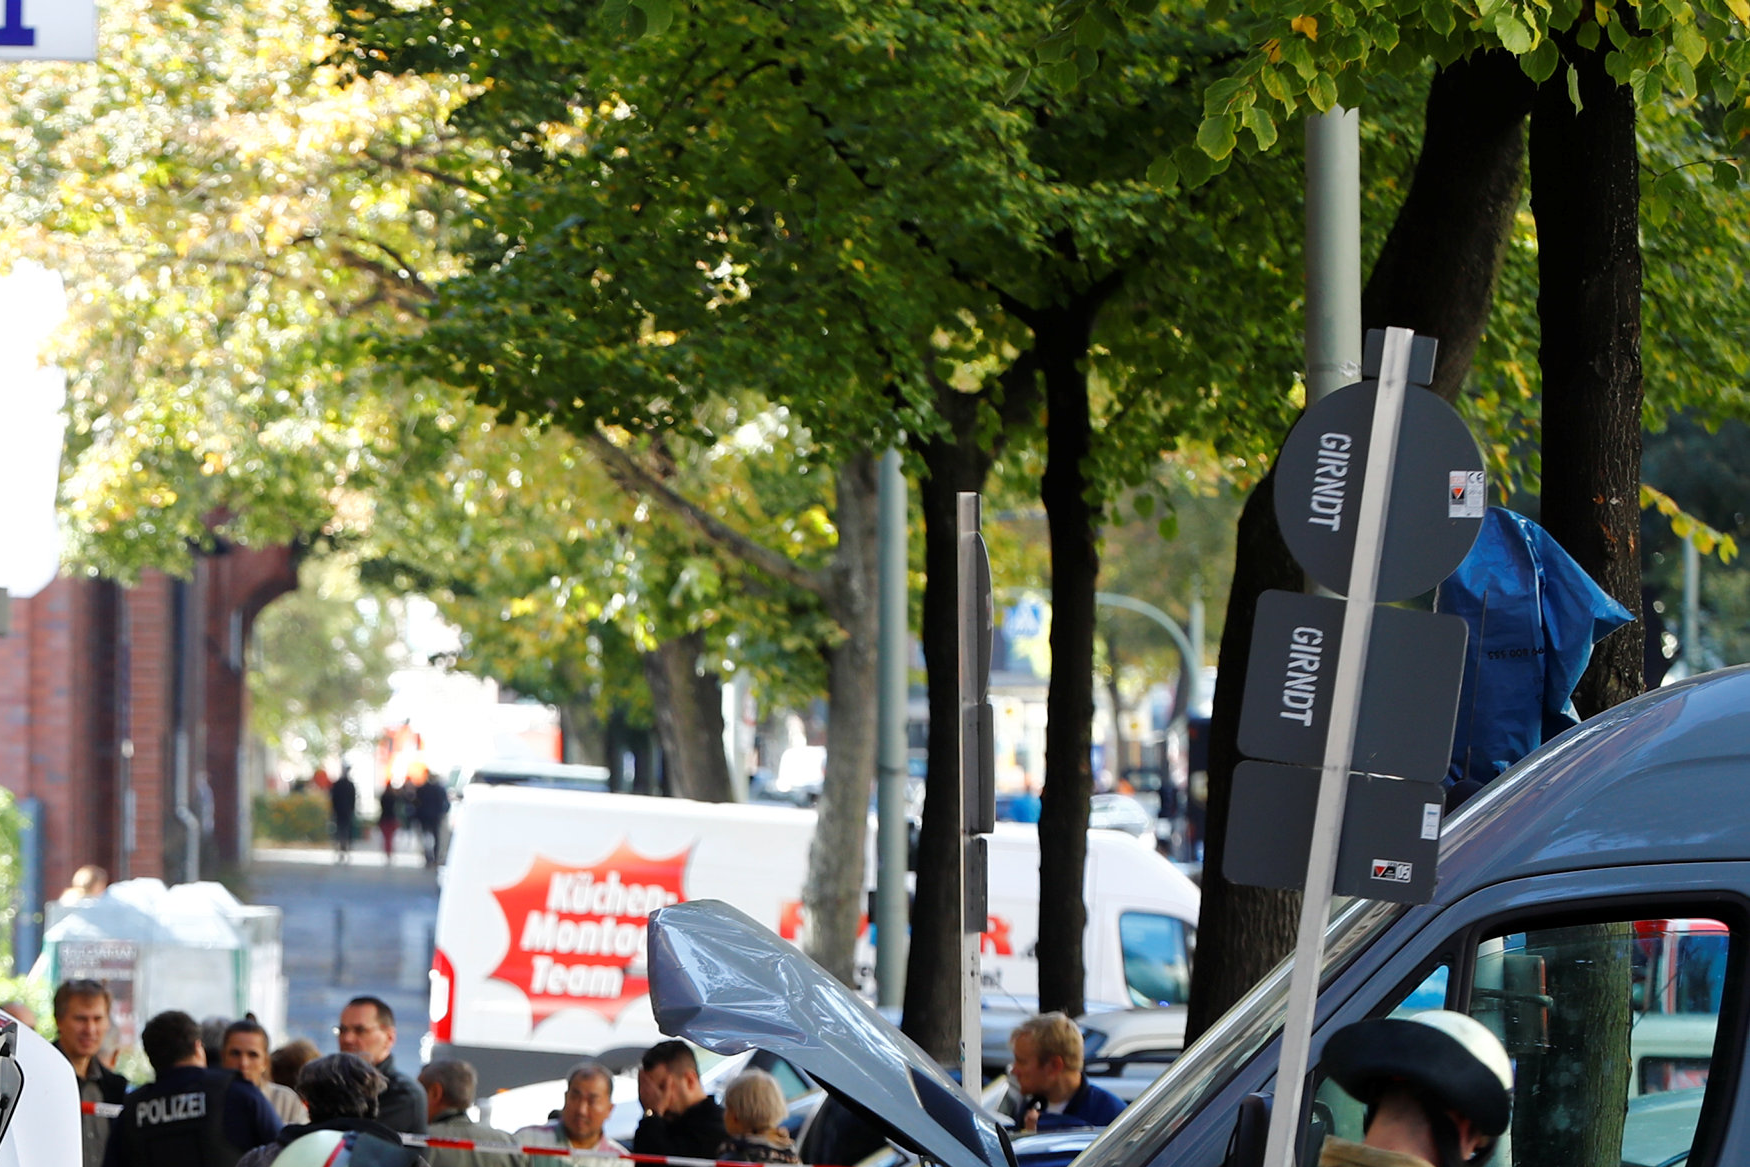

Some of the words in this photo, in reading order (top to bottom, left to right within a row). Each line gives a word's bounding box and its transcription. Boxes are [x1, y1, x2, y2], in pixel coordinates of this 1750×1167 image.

[1307, 431, 1352, 532] GIRNDT
[1279, 626, 1324, 728] GIRNDT
[546, 870, 678, 918] Küchen-
[529, 955, 625, 998] Team
[136, 1091, 207, 1128] POLIZEI
